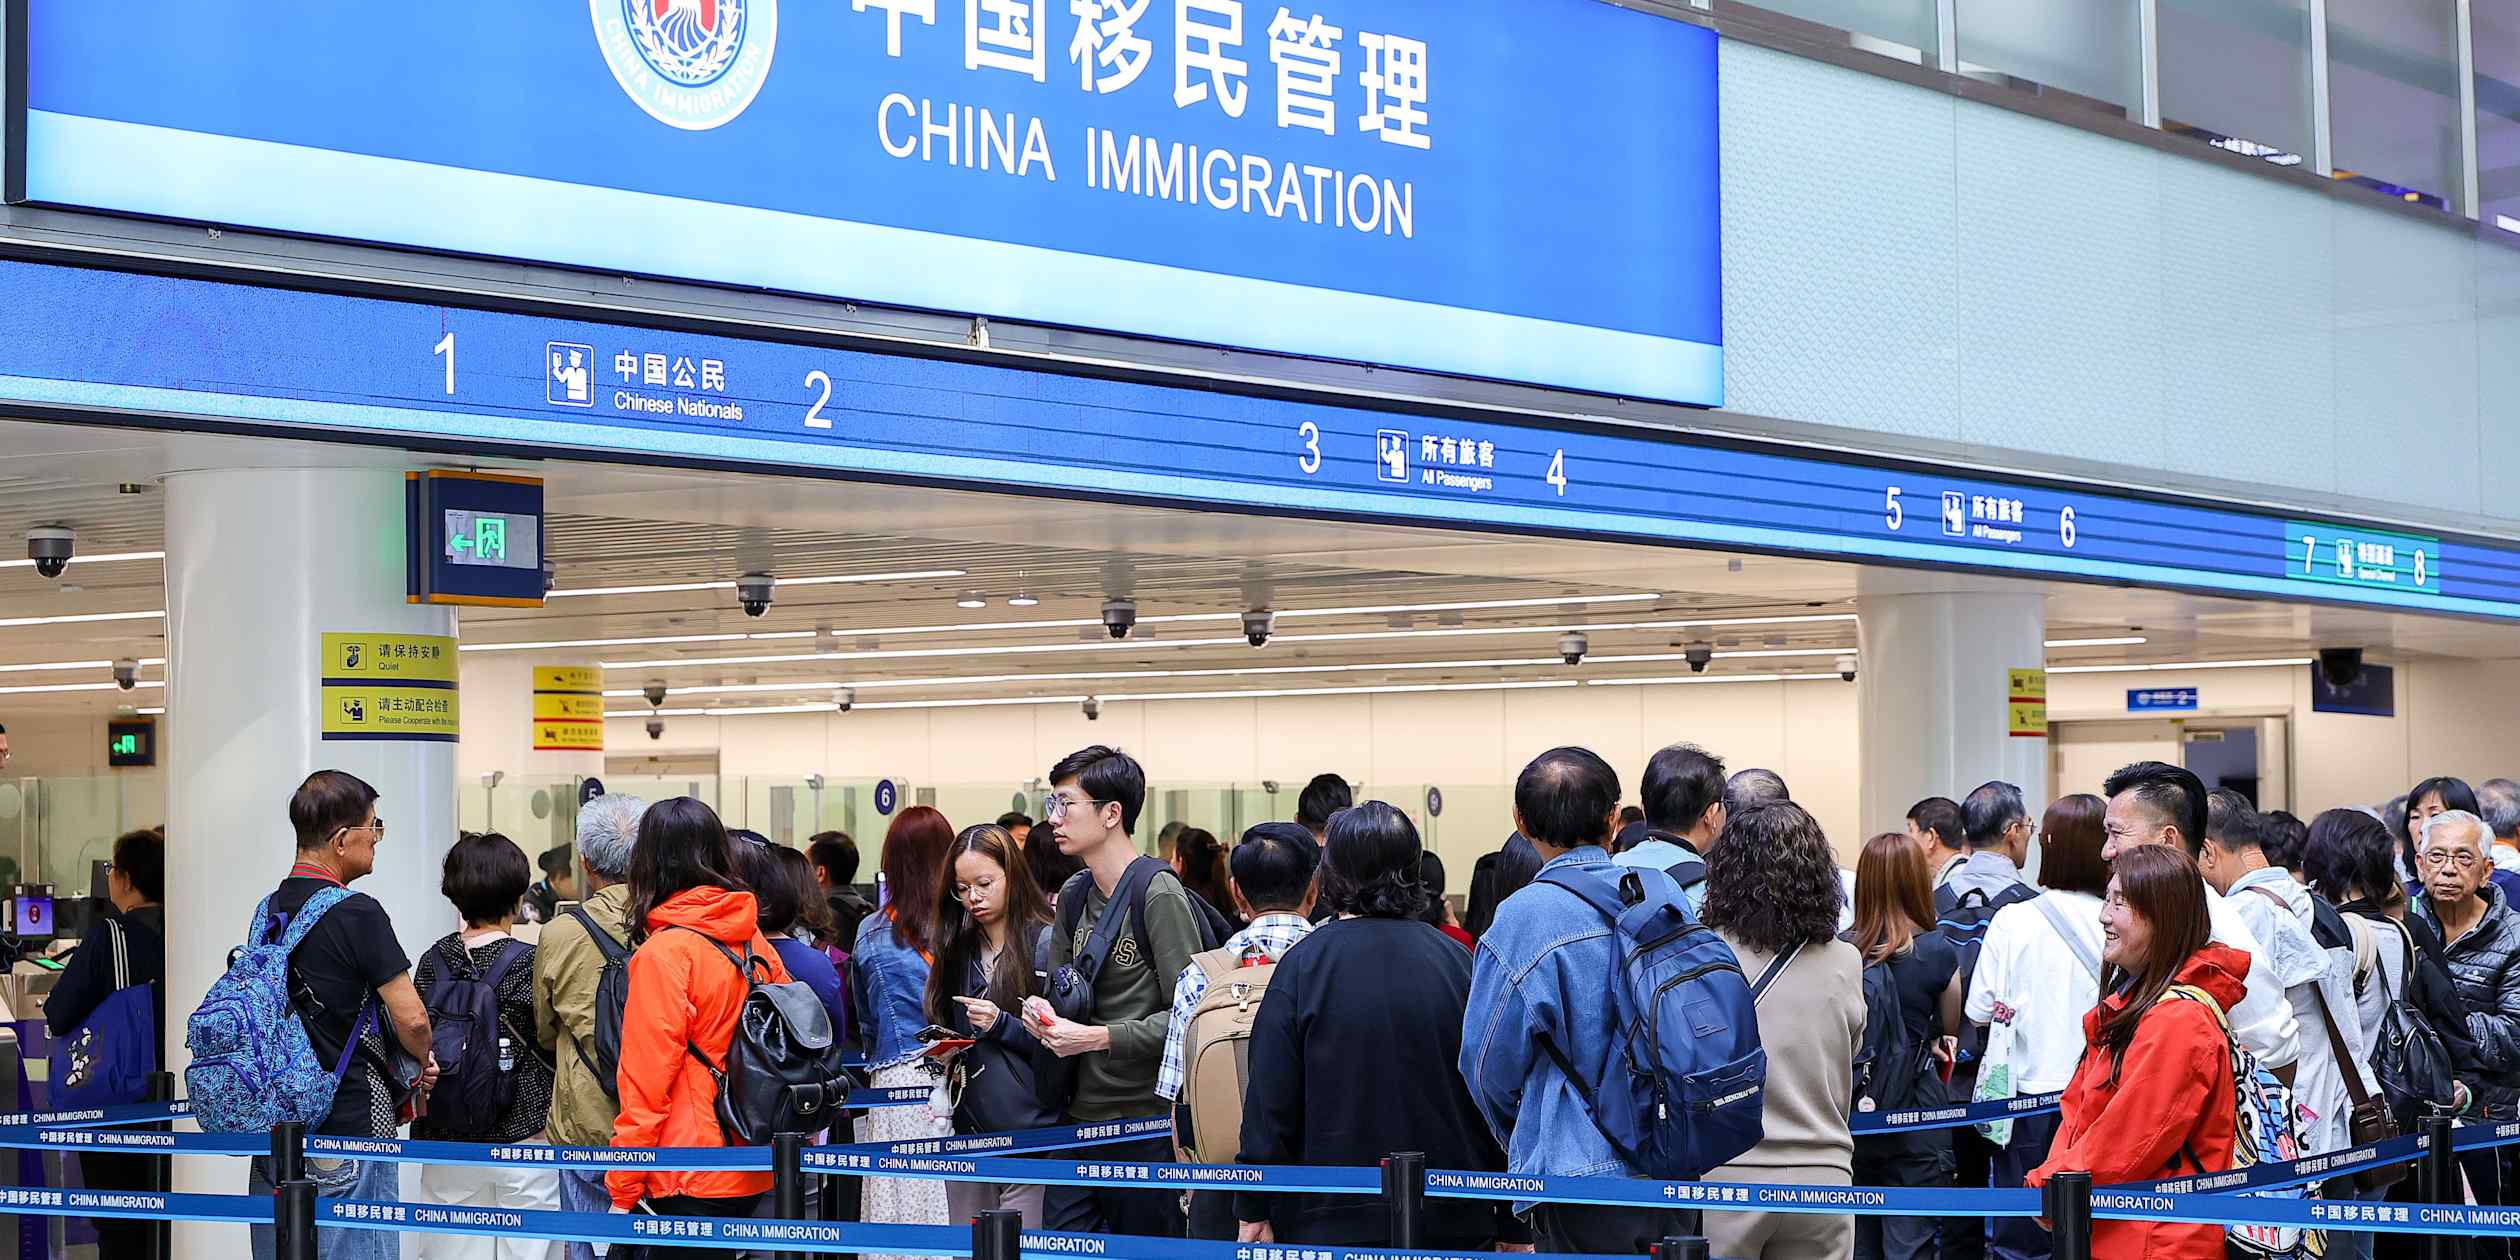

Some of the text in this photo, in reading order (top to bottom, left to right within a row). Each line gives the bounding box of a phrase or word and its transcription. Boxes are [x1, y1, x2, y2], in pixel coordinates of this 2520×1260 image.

[877, 92, 1413, 239] CHINA IMMIGRATION
[434, 332, 455, 395] 1
[614, 349, 726, 392] 中国公民
[614, 391, 743, 421] Chinese Nationals
[803, 370, 833, 429] 2
[1299, 421, 1321, 474] 3
[1421, 435, 1495, 468] 所有旅客
[1421, 470, 1493, 492] All Passengers
[1546, 448, 1567, 497] 4
[1885, 486, 1903, 531] 5
[1972, 495, 2024, 524] 所有旅客
[2060, 506, 2076, 549] 6
[2302, 535, 2316, 575] 7
[2414, 549, 2426, 586] 8
[378, 662, 400, 671] Quiet
[378, 697, 449, 713] 请主动配合检查
[588, 787, 598, 801] 5
[881, 788, 891, 807] 6
[887, 1089, 929, 1101] 中国移民管理
[0, 1109, 104, 1126] 民管理 CHINA IMMIGRATION
[40, 1131, 175, 1146] 中国移民管理 CHINA IMMIGRATION
[1076, 1124, 1121, 1140] 中国移民管理
[1125, 1123, 1145, 1134] CHINA
[313, 1138, 341, 1149] CHINA
[342, 1140, 402, 1153] IMMIGRATION
[490, 1147, 656, 1163] 中国移民管理 CHINA IMMIGRATION
[891, 1136, 1013, 1155] 中国移民管理 CHINA IMMIGRATION
[803, 1151, 975, 1173] 中国移民管理 CHINA IMMIGRATION
[2294, 1158, 2329, 1176] 中国移民管理
[1076, 1164, 1263, 1182] 中国移民管理 CHINA IMMIGRATION
[1427, 1174, 1544, 1192] CHINA IMMIGRATION
[0, 1189, 165, 1210] 中国移民管理 CHINA IMMIGRATION
[1663, 1184, 1884, 1205] 中国移民管理 CHINA IMMIGRATION
[2090, 1195, 2174, 1211] MMIGRATION
[333, 1203, 522, 1227] 中国移民管理 CHINA IMMIGRATION
[2311, 1203, 2409, 1222] 中国移民管理
[2420, 1209, 2464, 1223] CHINA
[633, 1219, 840, 1241] 中国移民管理 CHINA IMMIGRATION
[1018, 1235, 1105, 1253] IMMIGRATION
